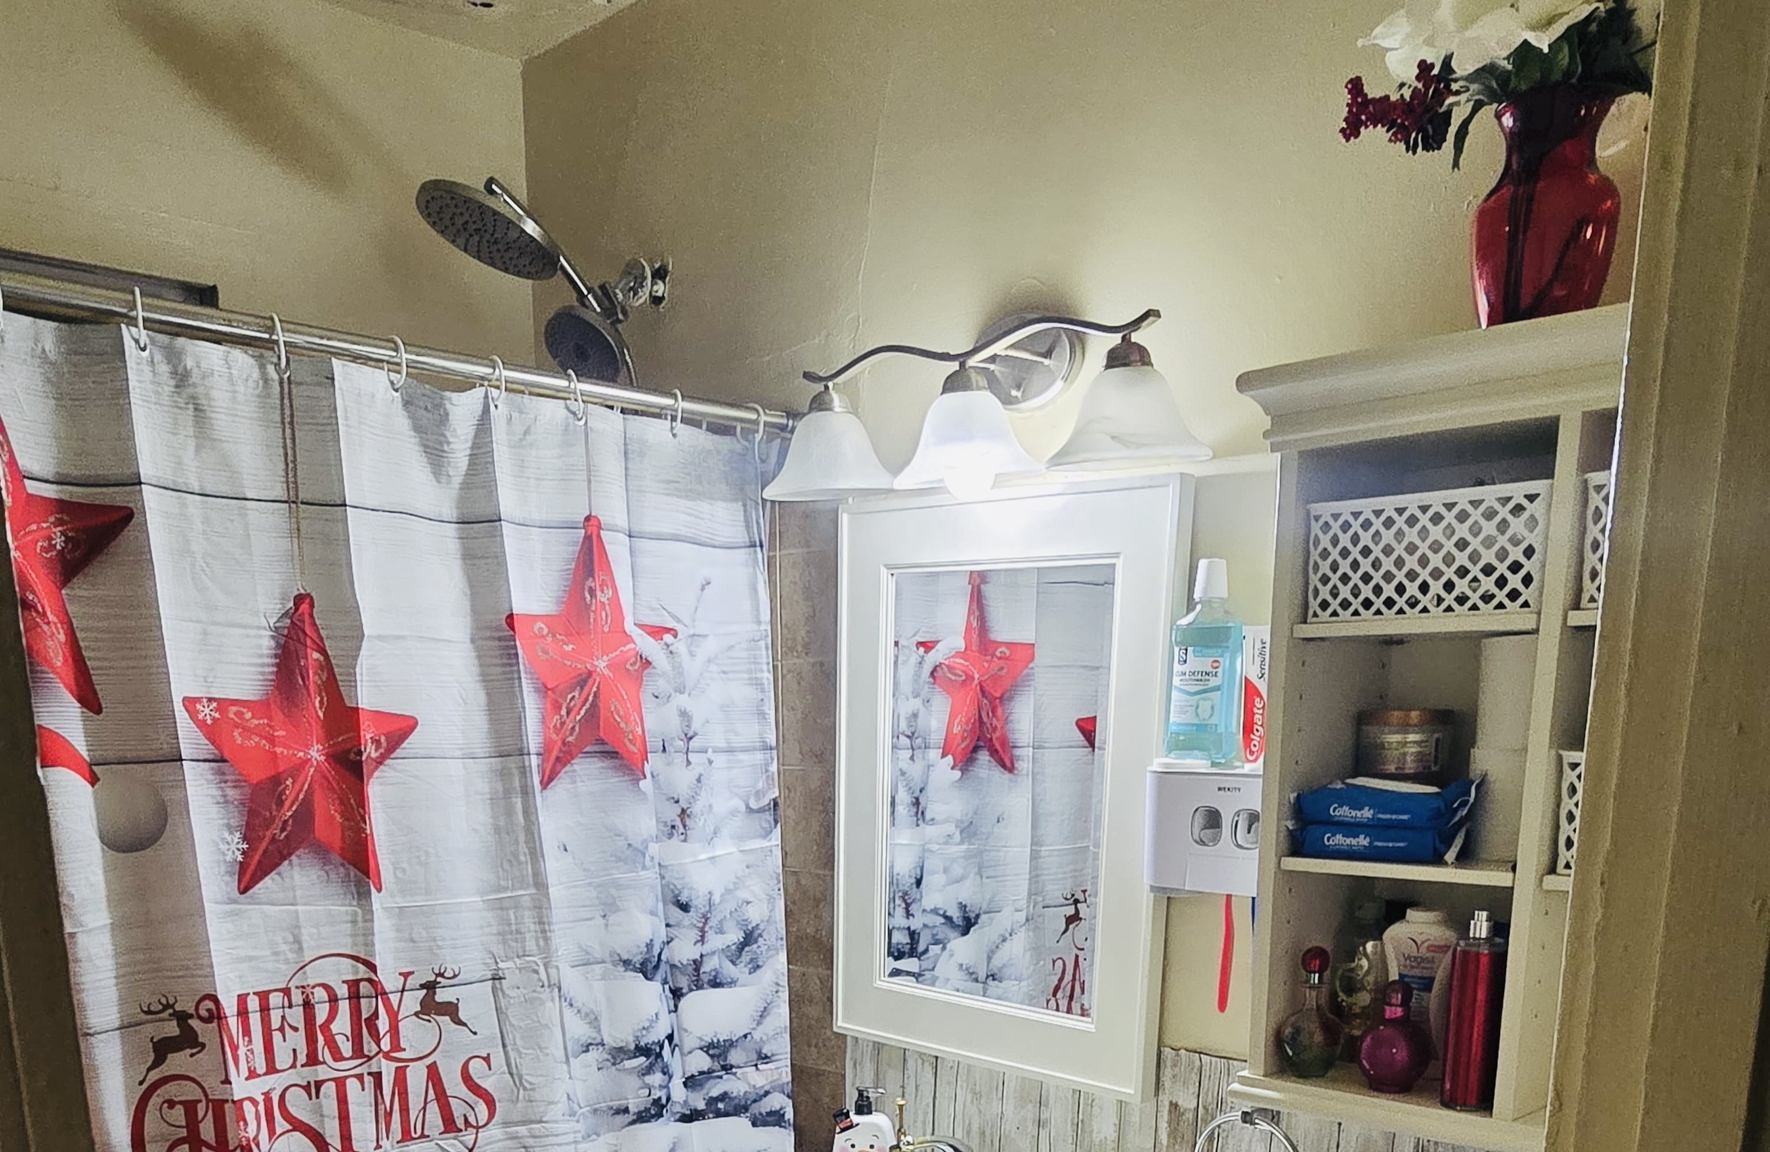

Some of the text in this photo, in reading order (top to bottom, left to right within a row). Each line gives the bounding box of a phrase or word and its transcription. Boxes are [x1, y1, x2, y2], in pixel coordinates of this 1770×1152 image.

[1257, 638, 1267, 680] Sensitive
[1188, 670, 1219, 678] DEFENSE
[1246, 697, 1264, 761] Colgate
[1329, 803, 1374, 819] Cottonelle
[1324, 832, 1370, 847] Cottonelle
[194, 953, 441, 1085] MERRY
